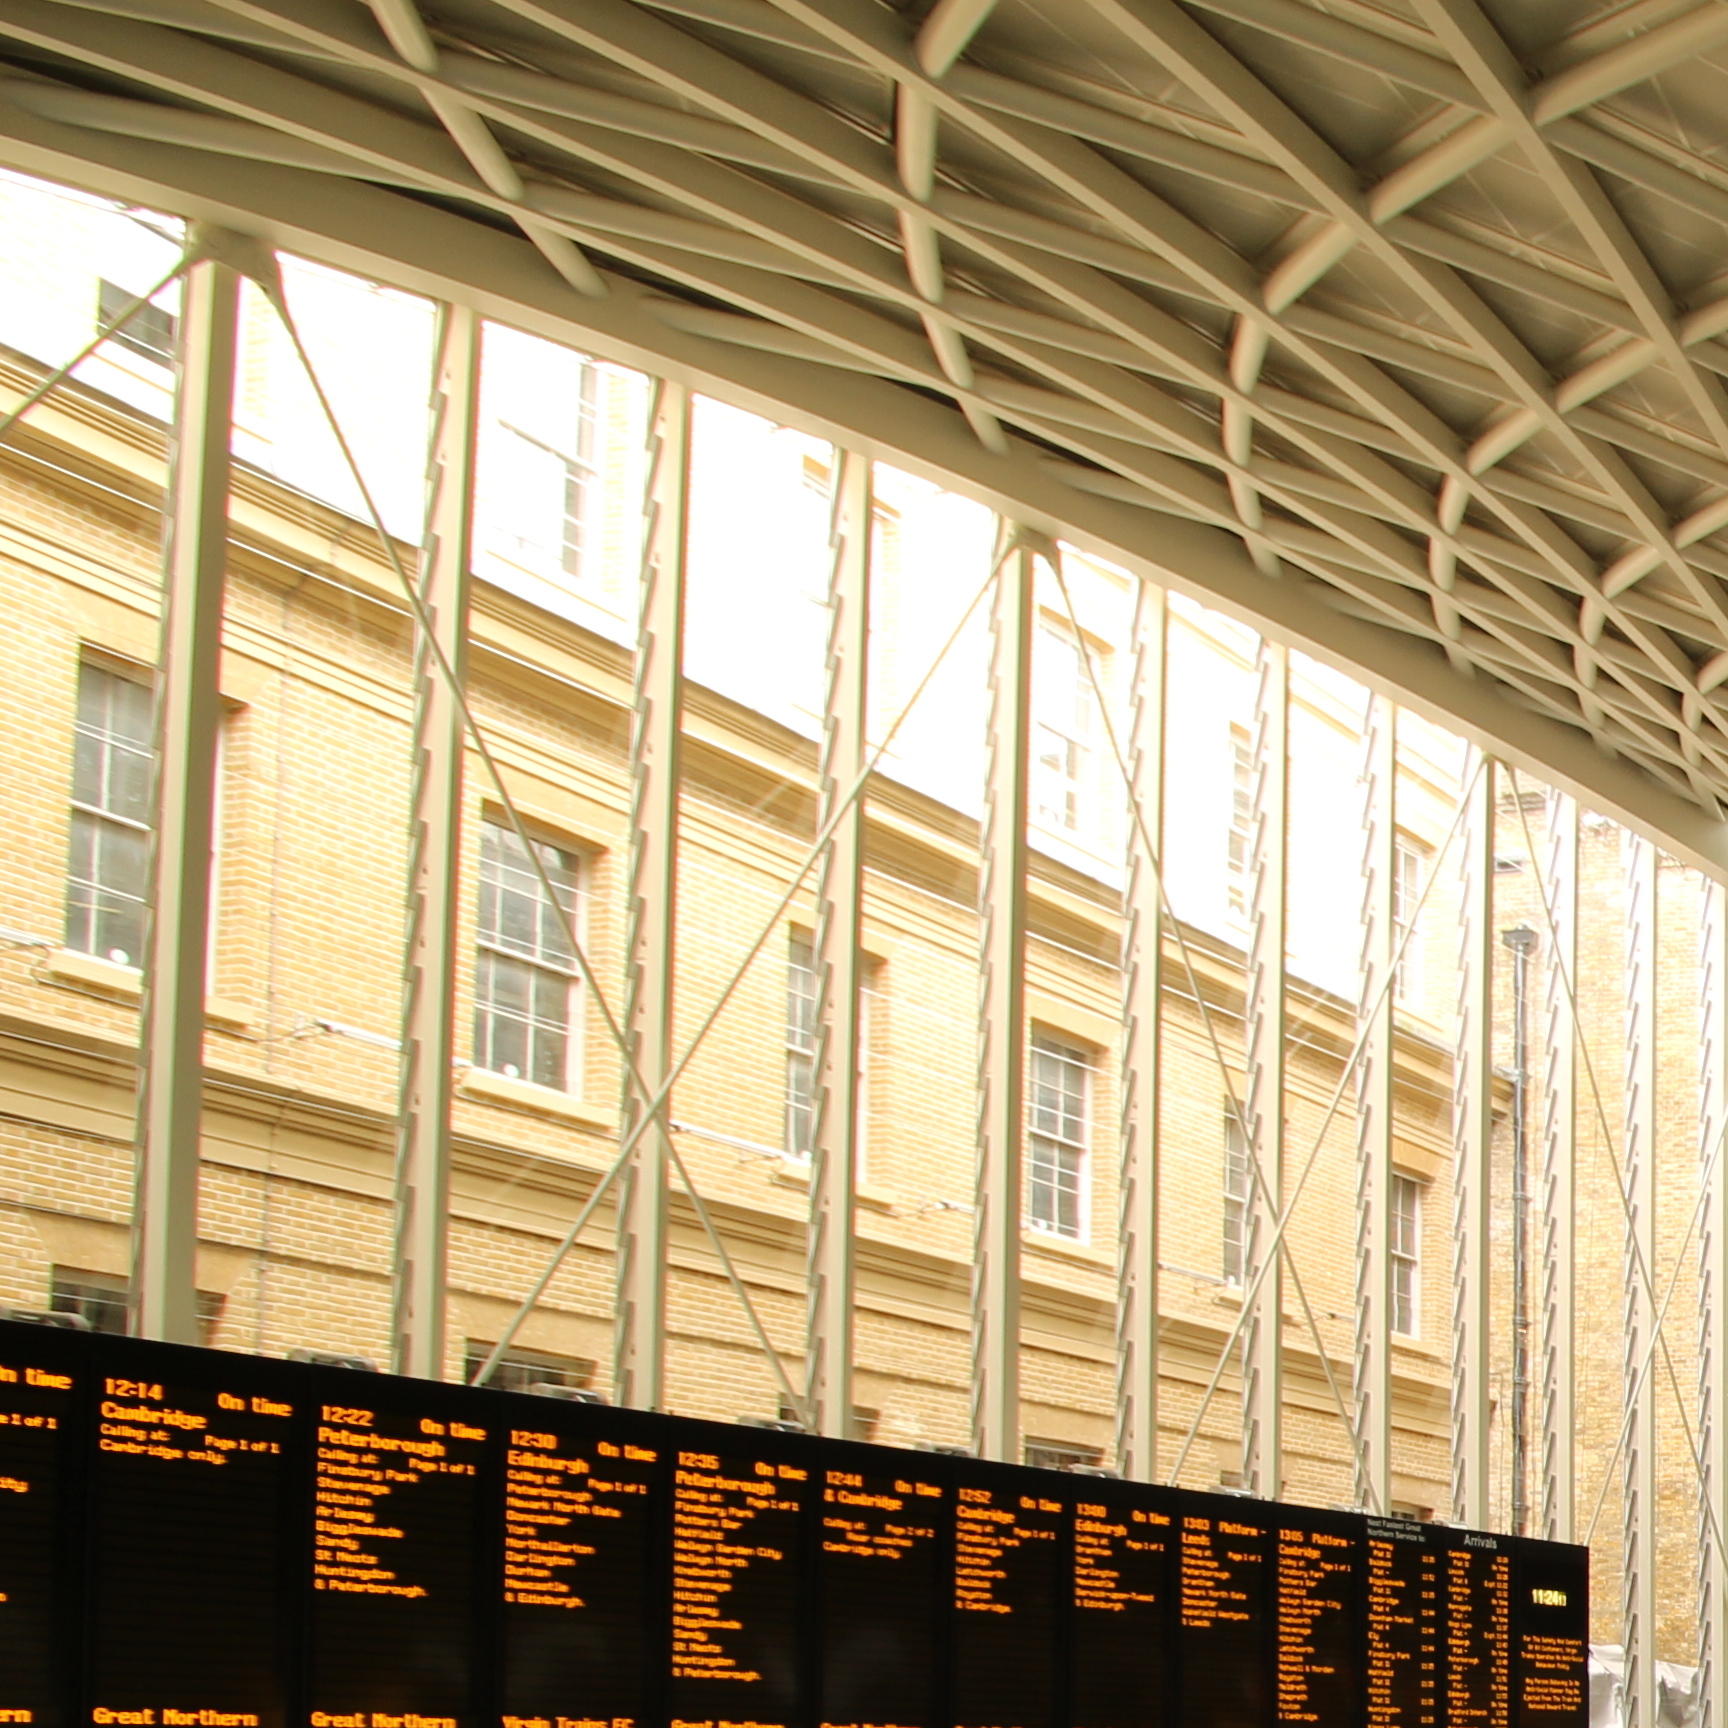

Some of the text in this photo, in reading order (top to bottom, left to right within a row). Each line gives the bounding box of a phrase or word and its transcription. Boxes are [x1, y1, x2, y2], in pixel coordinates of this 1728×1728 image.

[105, 1377, 163, 1401] 12:14
[217, 1392, 293, 1417] On time
[100, 1401, 207, 1430] Cambridge
[321, 1405, 374, 1427] 12:22
[100, 1423, 148, 1441] Calling
[420, 1418, 487, 1441] On time
[511, 1430, 557, 1450] 12:30
[99, 1439, 184, 1460] Cambridge
[205, 1434, 280, 1454] Page 1 of 1
[318, 1426, 446, 1458] Peterborough
[597, 1441, 657, 1462] On time
[507, 1450, 589, 1475] Edinburgh
[678, 1451, 719, 1470] 12:35
[317, 1461, 419, 1483] Finsbury Park
[317, 1476, 391, 1496] Stevenage
[675, 1470, 776, 1496] Peterborough
[316, 1491, 373, 1506] Hitchin
[837, 1490, 903, 1511] Cambridge
[957, 1505, 1015, 1524] Cambridge
[1075, 1519, 1127, 1537] Edinburgh
[316, 1534, 360, 1551] Sandy
[1182, 1532, 1210, 1546] Leeds
[1463, 1534, 1498, 1550] Arrivals
[92, 1706, 259, 1727] Great Northern
[310, 1711, 367, 1728] Great
